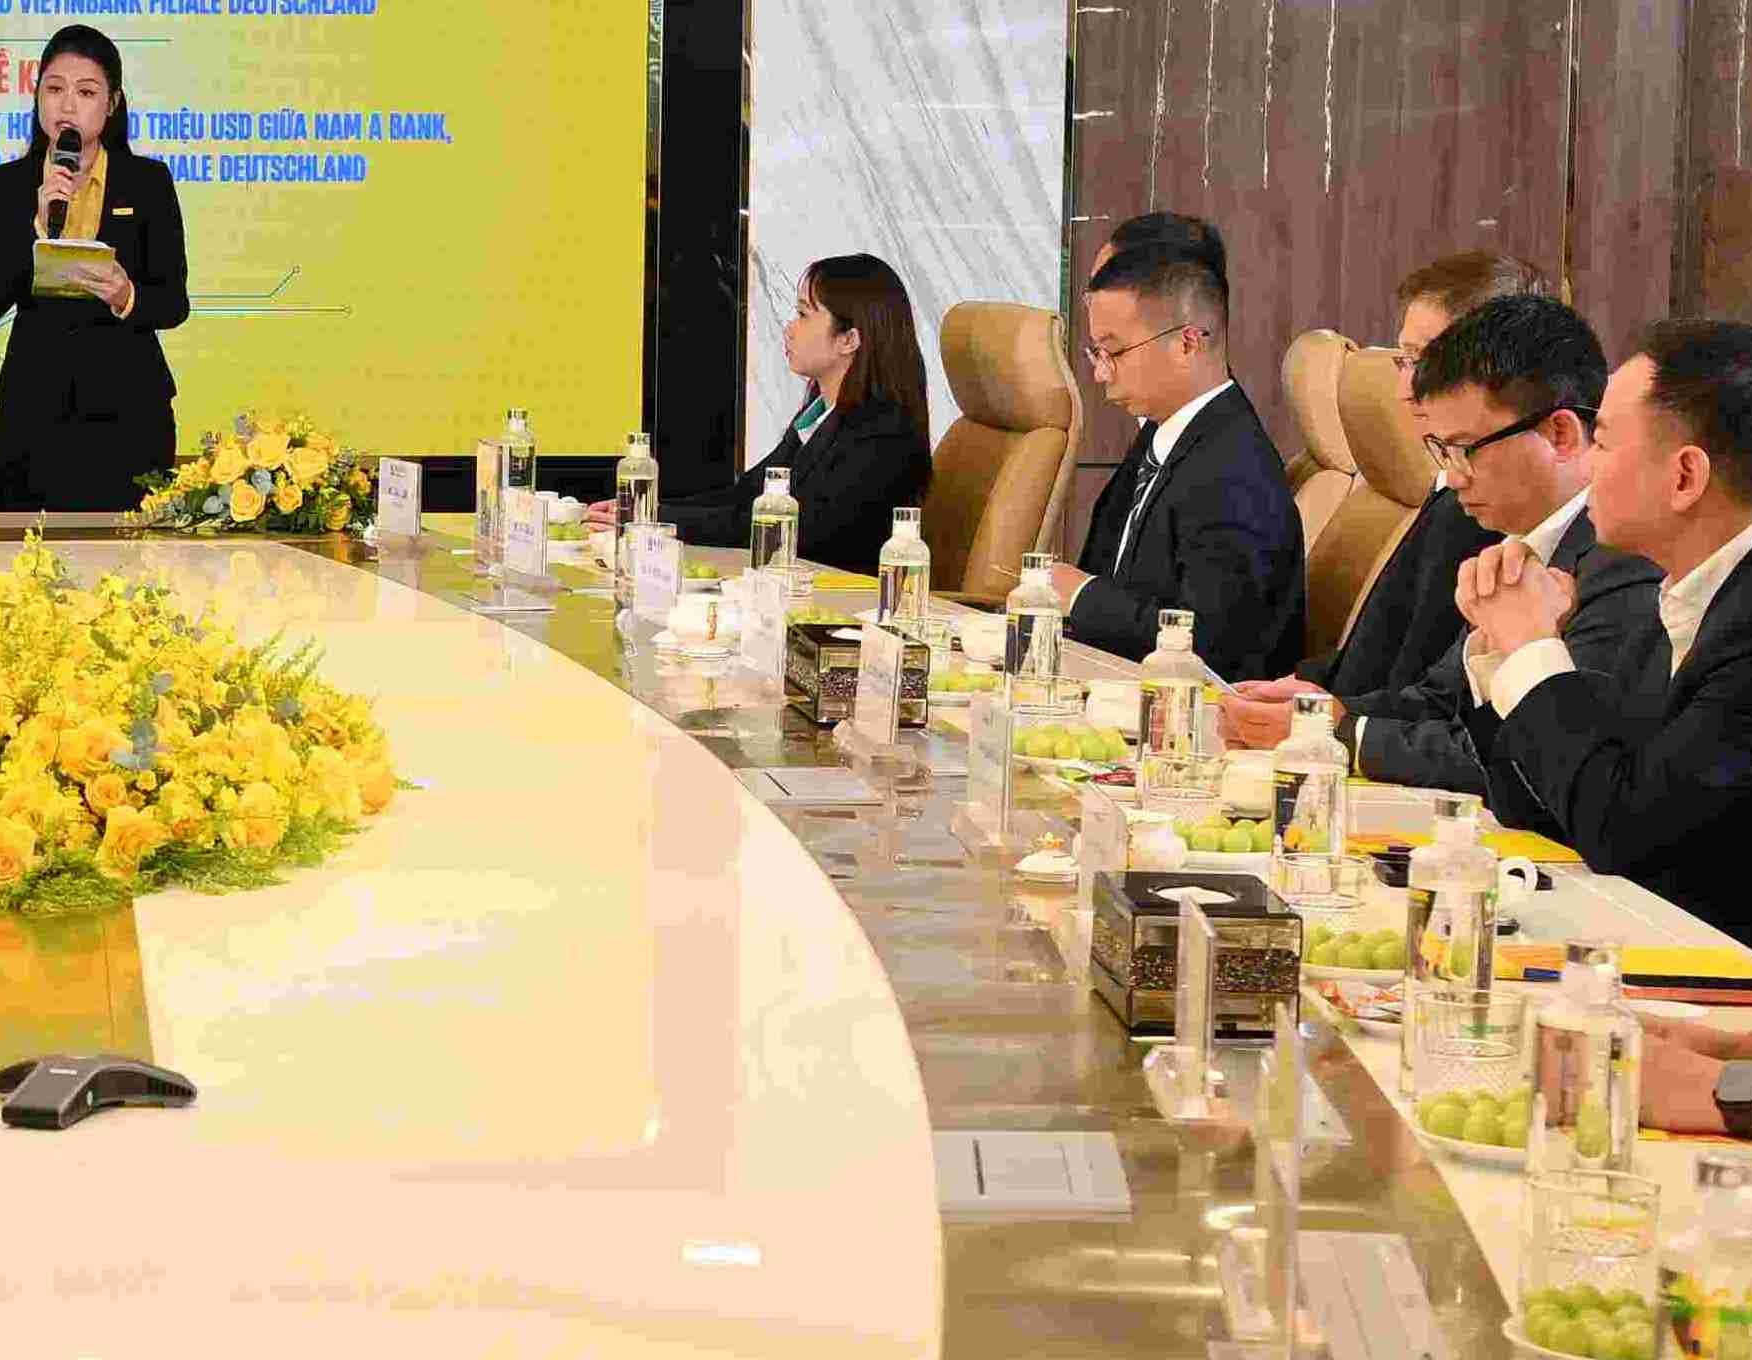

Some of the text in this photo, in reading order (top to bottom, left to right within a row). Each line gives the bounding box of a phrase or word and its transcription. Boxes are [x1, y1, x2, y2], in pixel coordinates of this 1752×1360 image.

[146, 106, 204, 144] TRIỆU
[210, 111, 252, 141] USD
[258, 107, 308, 141] GIỮA
[314, 111, 363, 141] NAM
[369, 111, 383, 141] A
[389, 111, 454, 145] BANK,
[220, 153, 367, 182] DEUTSCHLAND
